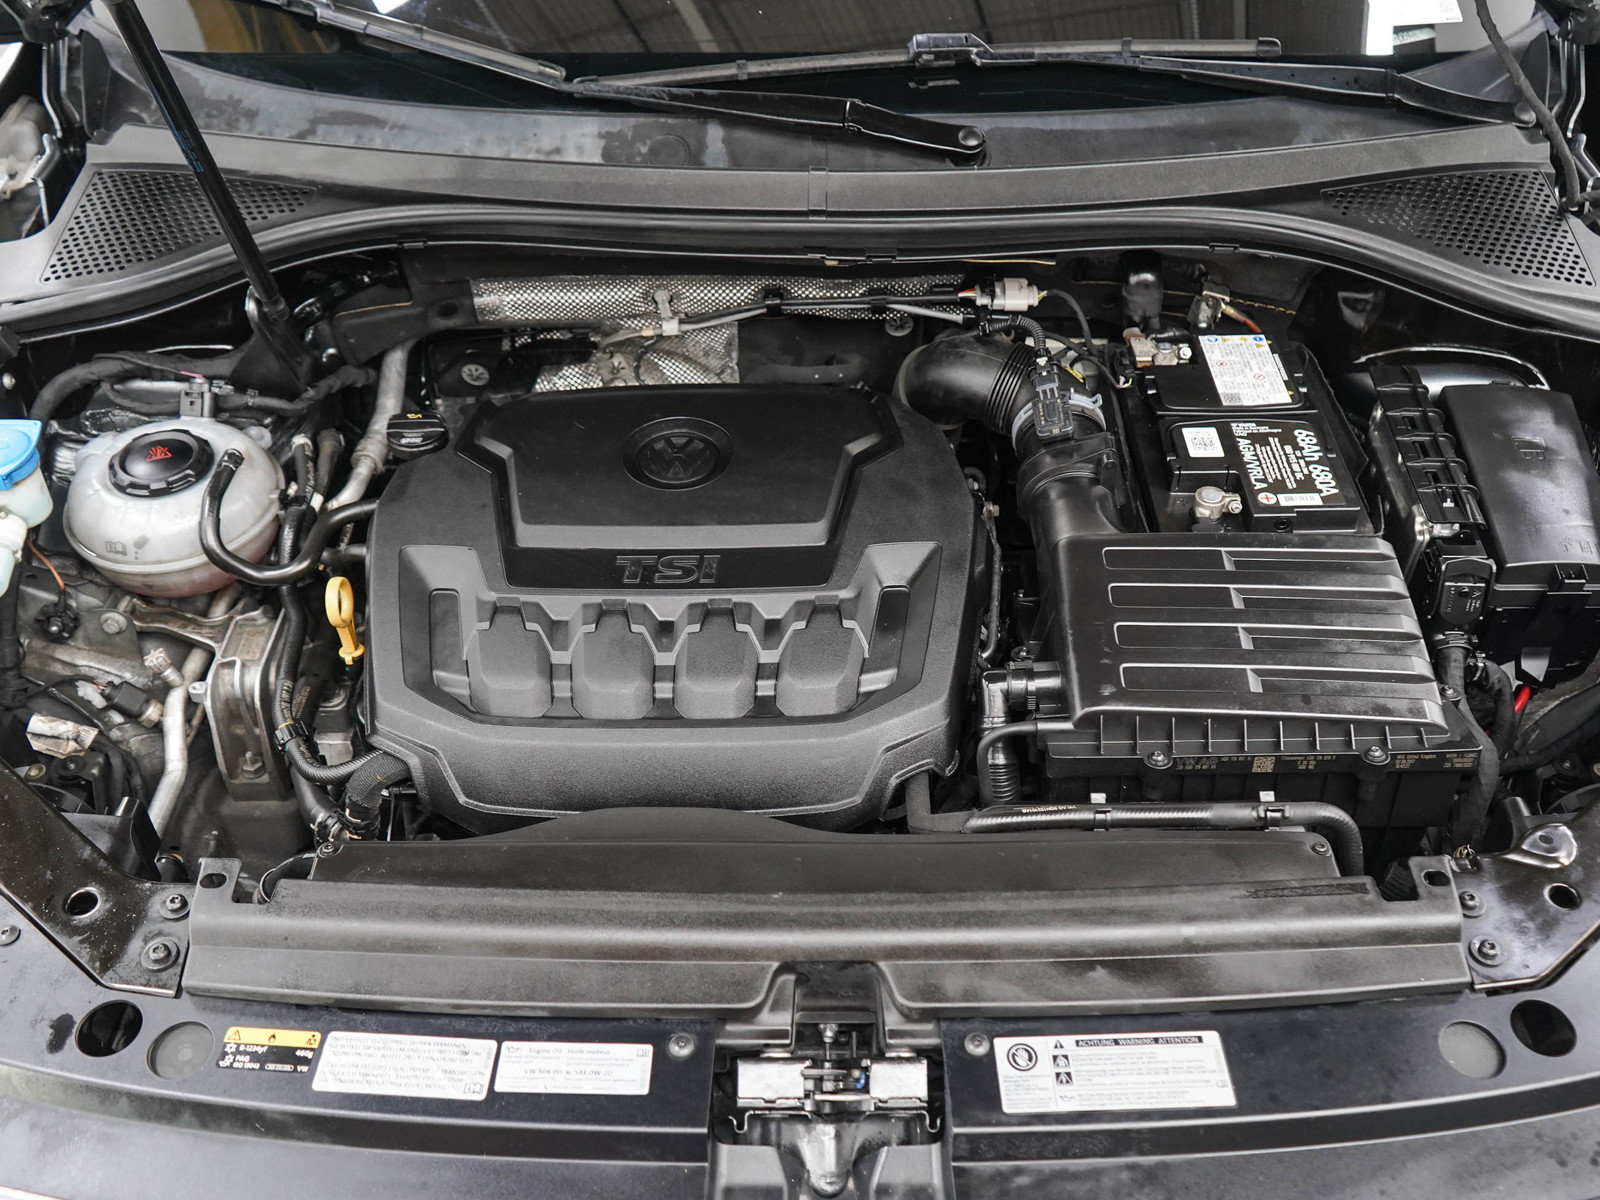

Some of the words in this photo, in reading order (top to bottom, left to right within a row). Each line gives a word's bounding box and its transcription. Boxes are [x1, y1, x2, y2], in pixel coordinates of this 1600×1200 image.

[1293, 429, 1324, 462] 68Ah
[1237, 438, 1268, 490] AGM/VRLA
[1308, 463, 1340, 497] 680A
[616, 555, 721, 583] TSI
[529, 1047, 551, 1055] Engine
[1078, 1039, 1116, 1047] ACHTUNG
[1117, 1037, 1156, 1046] WARNING
[1158, 1036, 1199, 1044] ATTENTION
